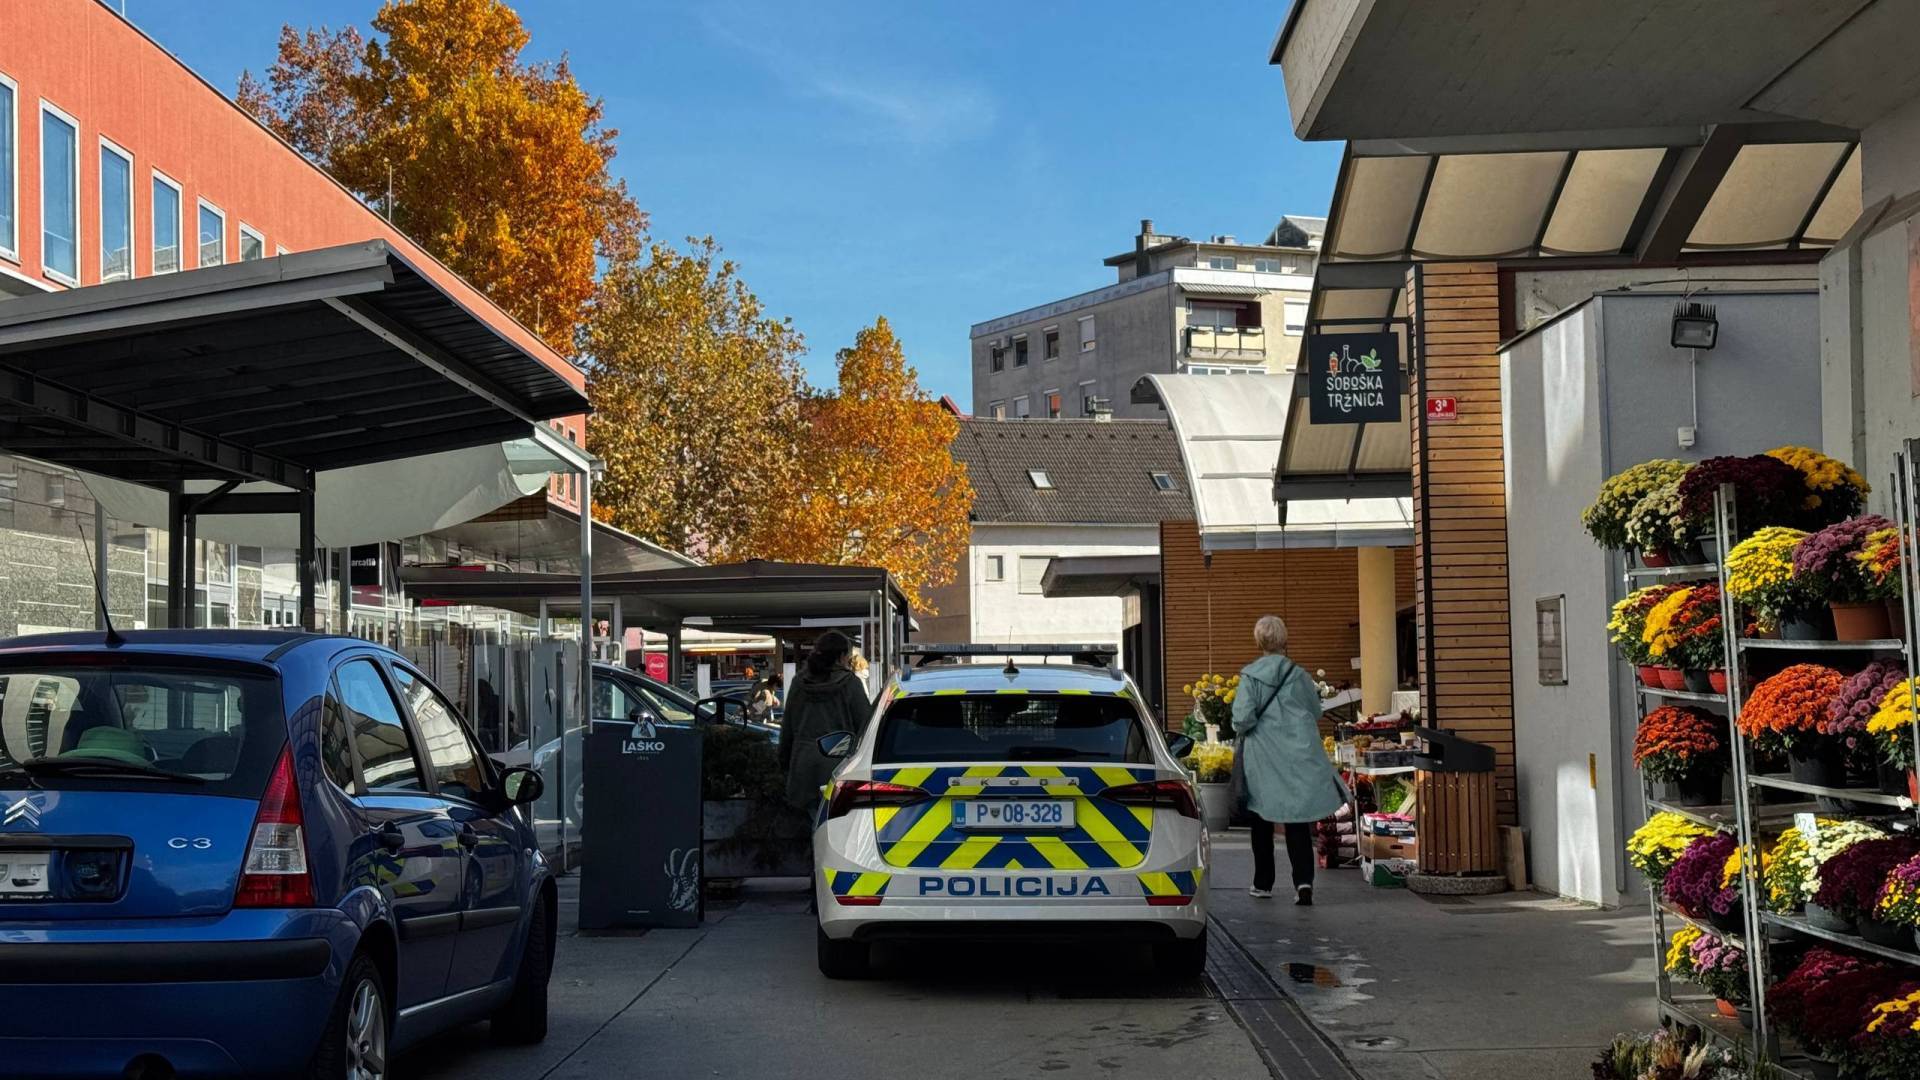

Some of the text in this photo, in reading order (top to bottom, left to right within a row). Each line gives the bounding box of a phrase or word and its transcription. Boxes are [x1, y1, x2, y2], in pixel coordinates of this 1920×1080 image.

[1326, 373, 1384, 391] SOBOŠKA
[621, 739, 665, 754] LAŠKO
[976, 803, 1063, 823] P 08-328
[167, 836, 213, 850] C3
[919, 875, 1111, 896] POLICIJA
